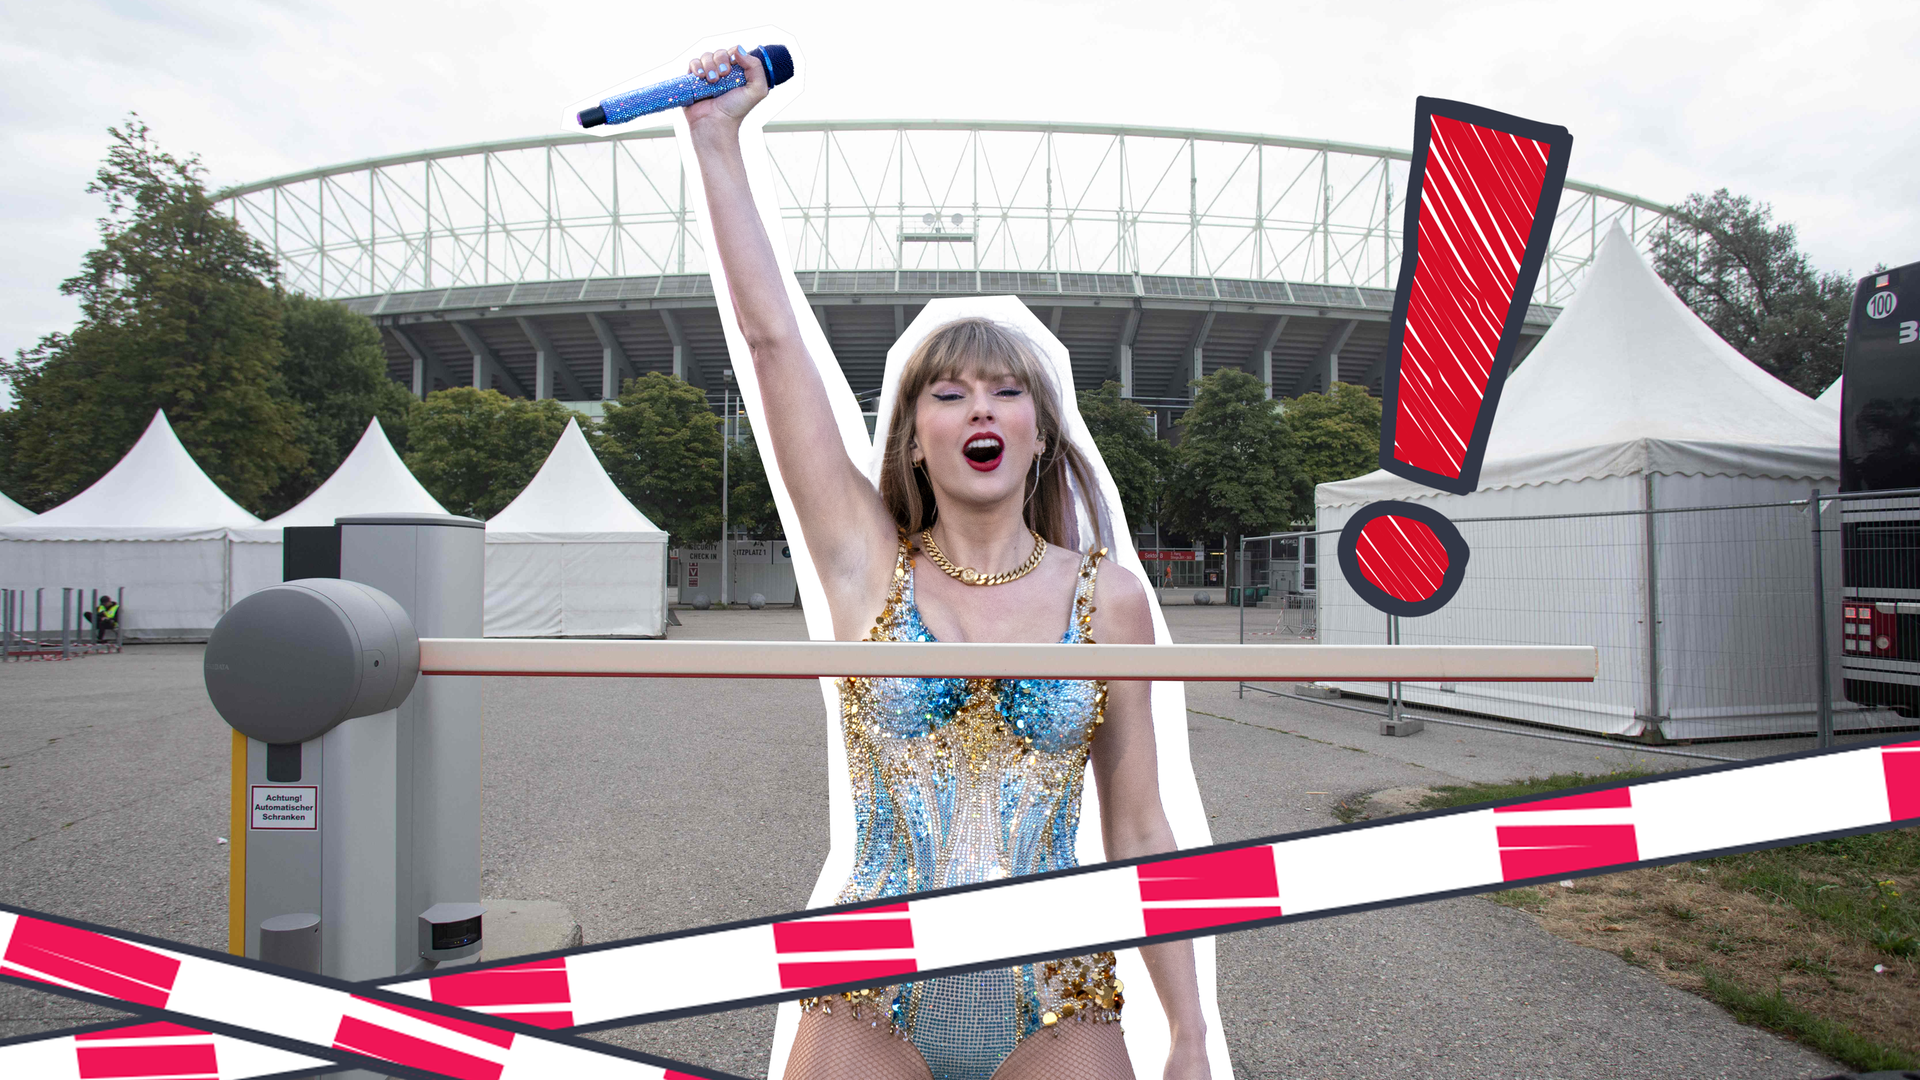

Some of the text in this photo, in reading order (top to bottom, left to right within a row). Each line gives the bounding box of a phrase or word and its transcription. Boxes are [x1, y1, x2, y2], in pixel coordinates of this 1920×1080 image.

[1871, 293, 1893, 317] 100
[266, 794, 303, 803] Achtung!
[254, 803, 315, 811] Automatischer
[262, 813, 306, 821] Schranken
